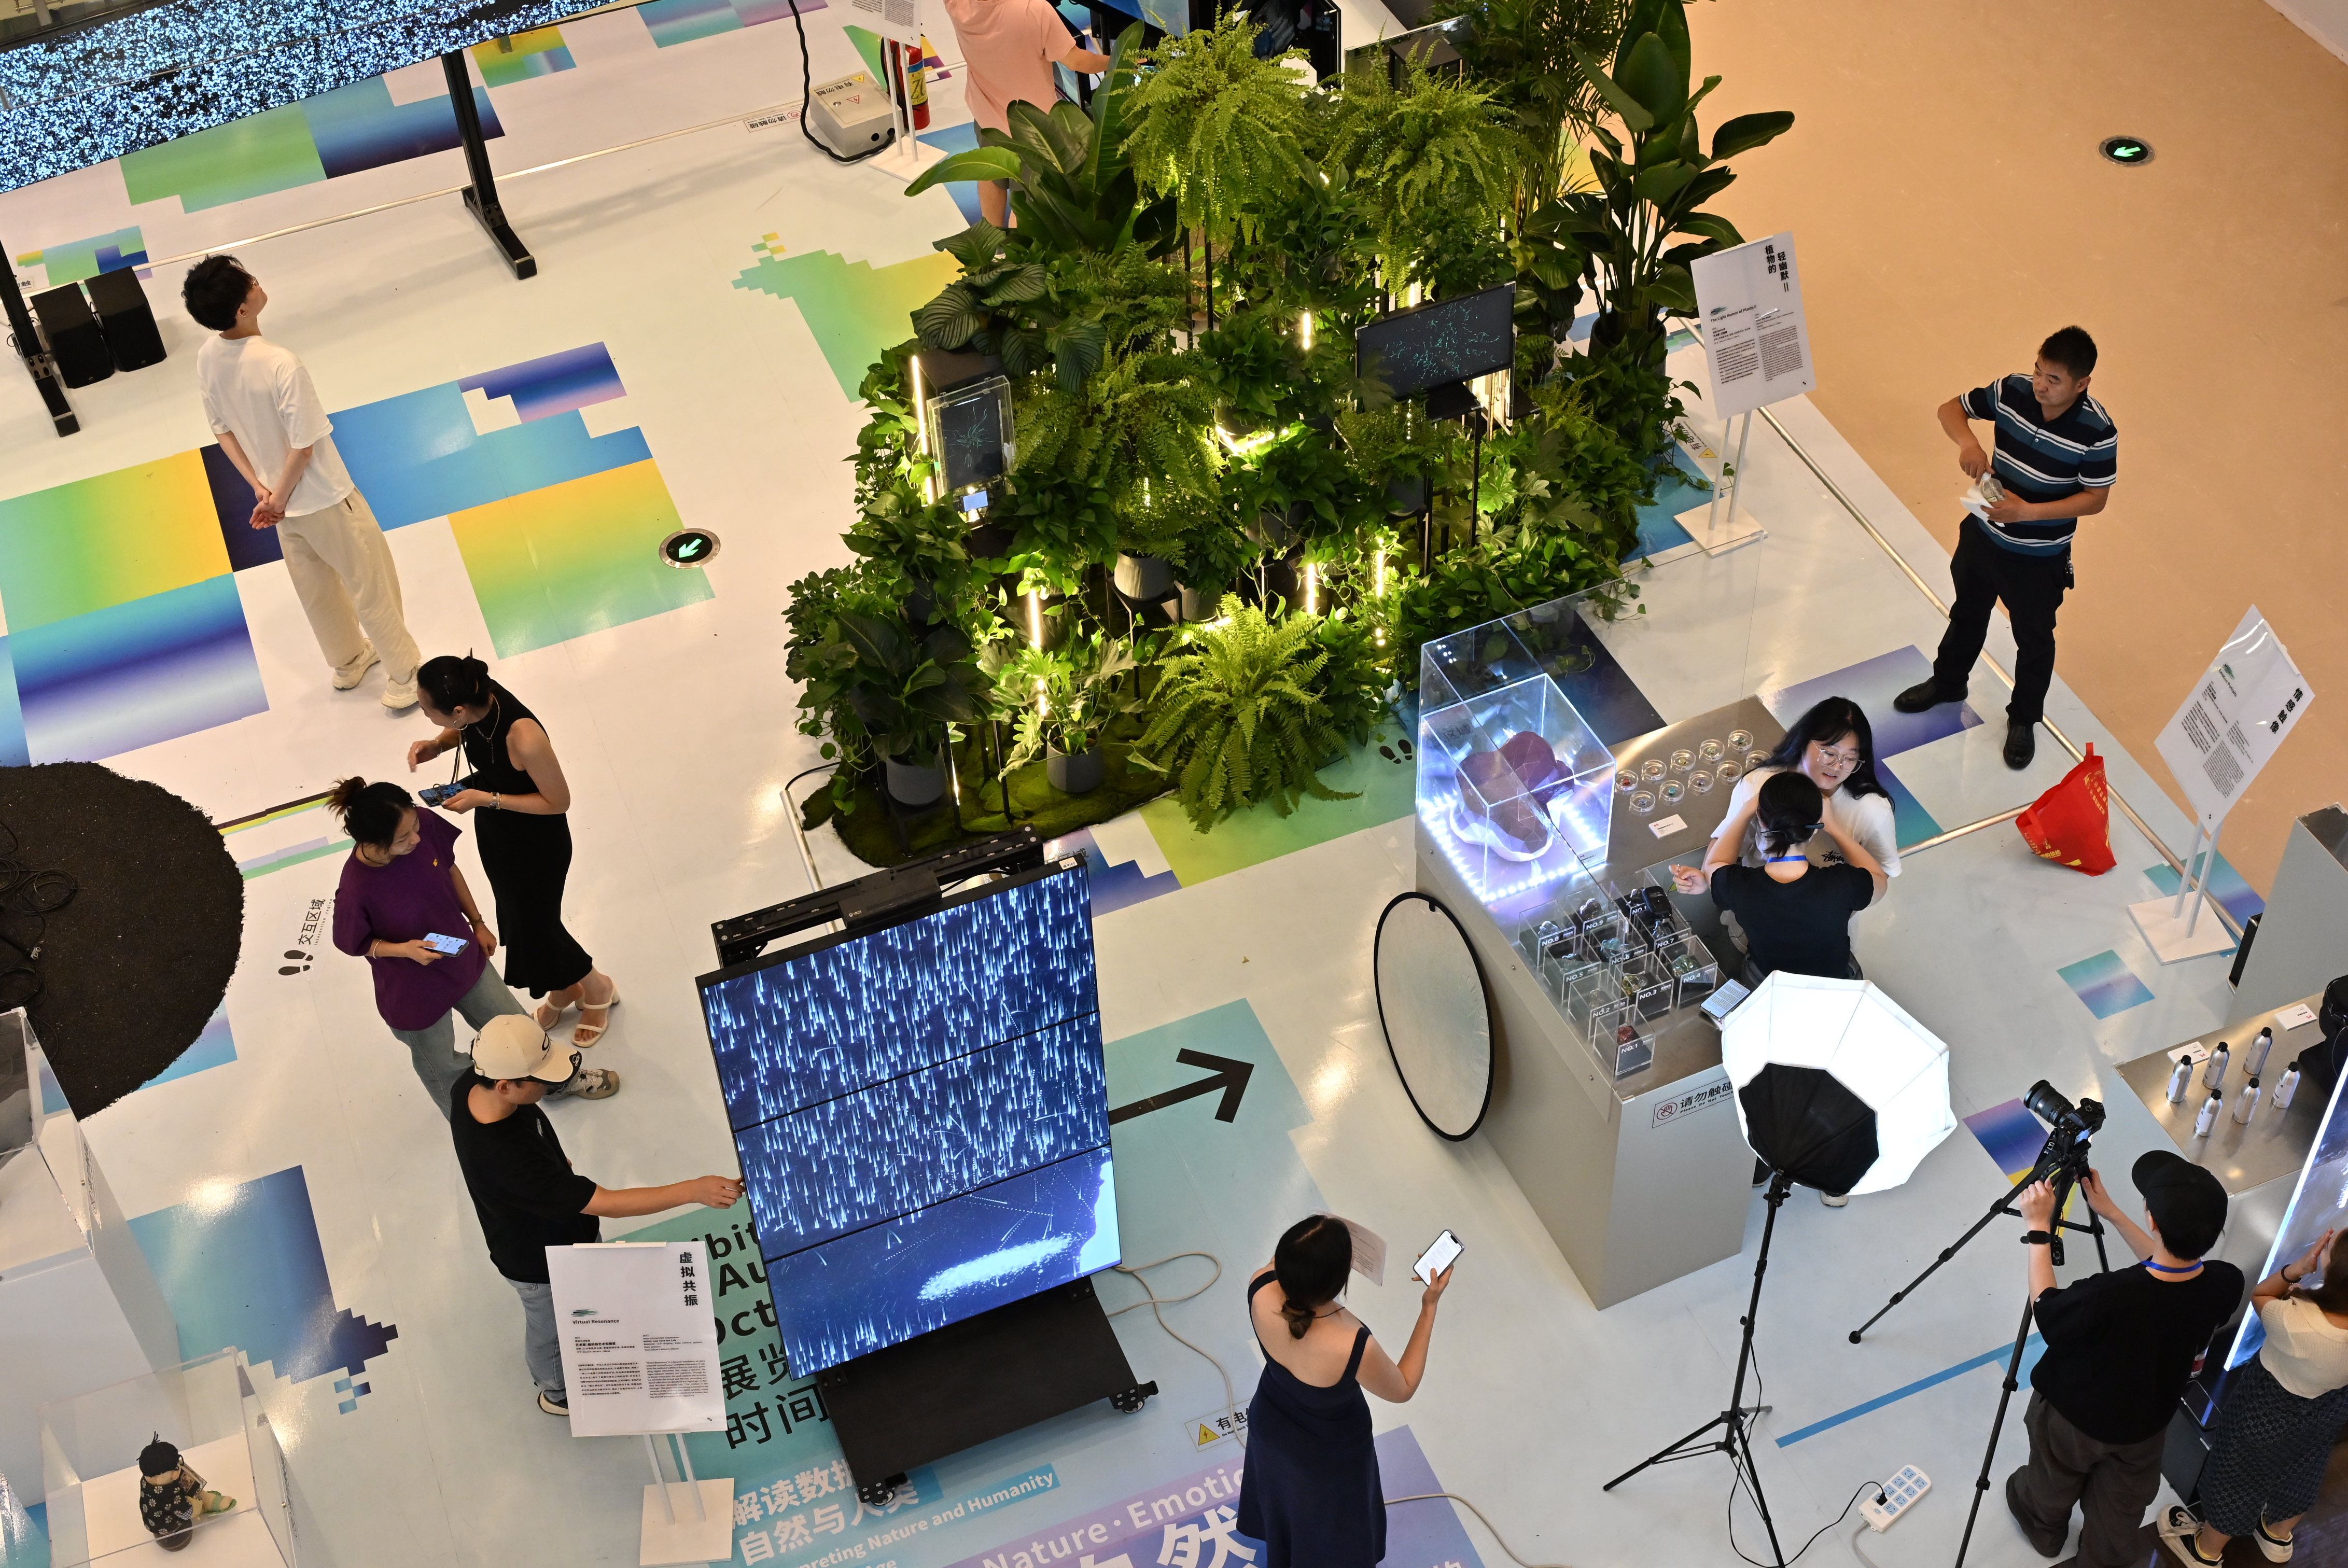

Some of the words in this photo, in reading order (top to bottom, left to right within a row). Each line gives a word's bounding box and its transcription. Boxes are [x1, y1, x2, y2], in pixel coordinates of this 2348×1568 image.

[816, 81, 854, 96] 有电勿触
[748, 115, 787, 129] 请勿触碰
[1765, 245, 1777, 274] 植物的
[2218, 668, 2228, 683] Emotion
[2227, 682, 2237, 697] Portraits
[2270, 687, 2303, 734] 情感触像
[298, 899, 326, 945] 交互区域
[1586, 920, 1603, 930] NO.9
[1542, 936, 1559, 946] NO.8
[1657, 938, 1674, 948] NO.7
[1612, 955, 1630, 965] NO.6
[1566, 972, 1583, 982] NO.5
[1683, 973, 1700, 983] NO.4
[1640, 989, 1657, 1000] NO.3
[1592, 1007, 1610, 1018] NO.2
[1621, 1043, 1638, 1054] NO.1
[1680, 1081, 1733, 1109] 请勿触碰
[679, 1252, 698, 1306] 虚拟共振
[719, 1262, 767, 1297] Au
[725, 1383, 829, 1449] 时间
[1215, 1408, 1249, 1430] 有电
[796, 1543, 866, 1568] preting
[868, 1519, 928, 1550] Nature
[932, 1503, 965, 1526] and
[968, 1472, 1053, 1513] Humanity
[982, 1523, 1109, 1568] Nature
